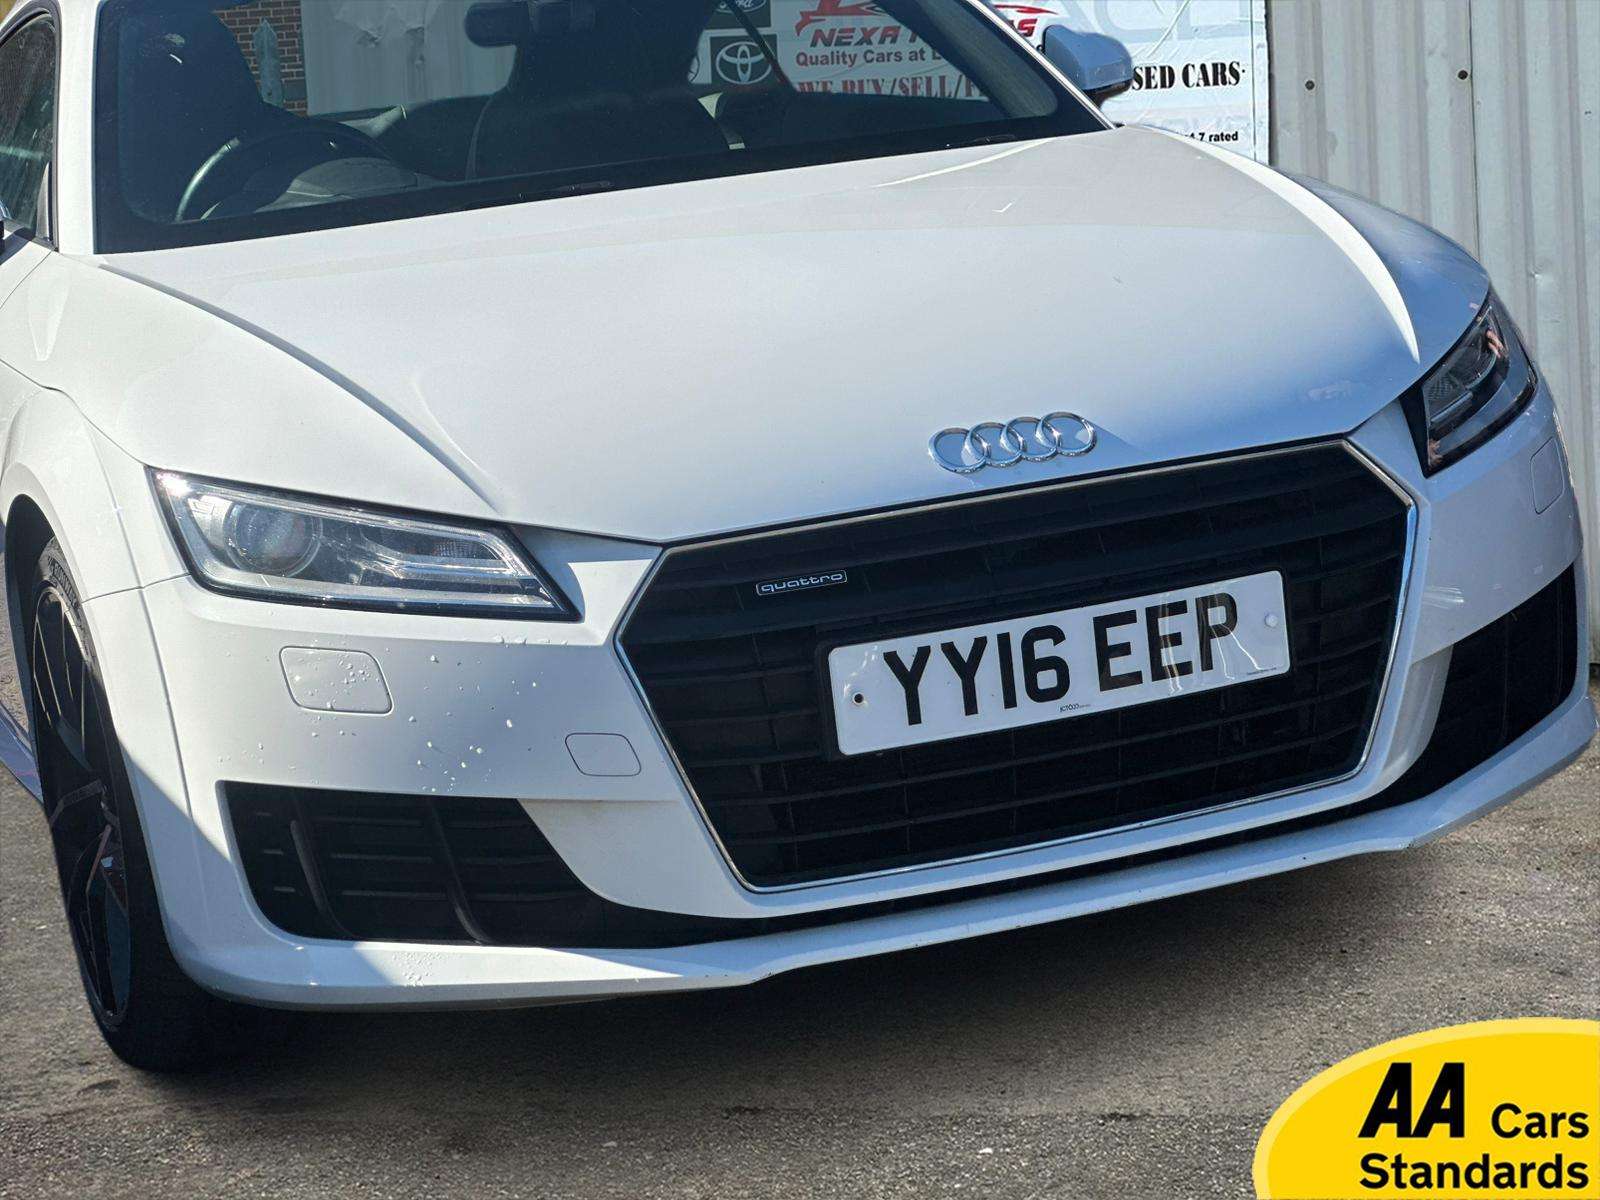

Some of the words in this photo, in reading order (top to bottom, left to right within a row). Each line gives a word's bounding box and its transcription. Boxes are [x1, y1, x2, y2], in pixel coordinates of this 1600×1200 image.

[810, 25, 901, 48] NEXA
[796, 50, 857, 68] Quality
[863, 49, 901, 64] Cars
[908, 47, 926, 62] at
[1131, 65, 1176, 91] SED
[1208, 131, 1239, 142] rated
[761, 573, 843, 592] quattro
[883, 624, 1071, 726] YY16
[1092, 592, 1238, 692] EEP
